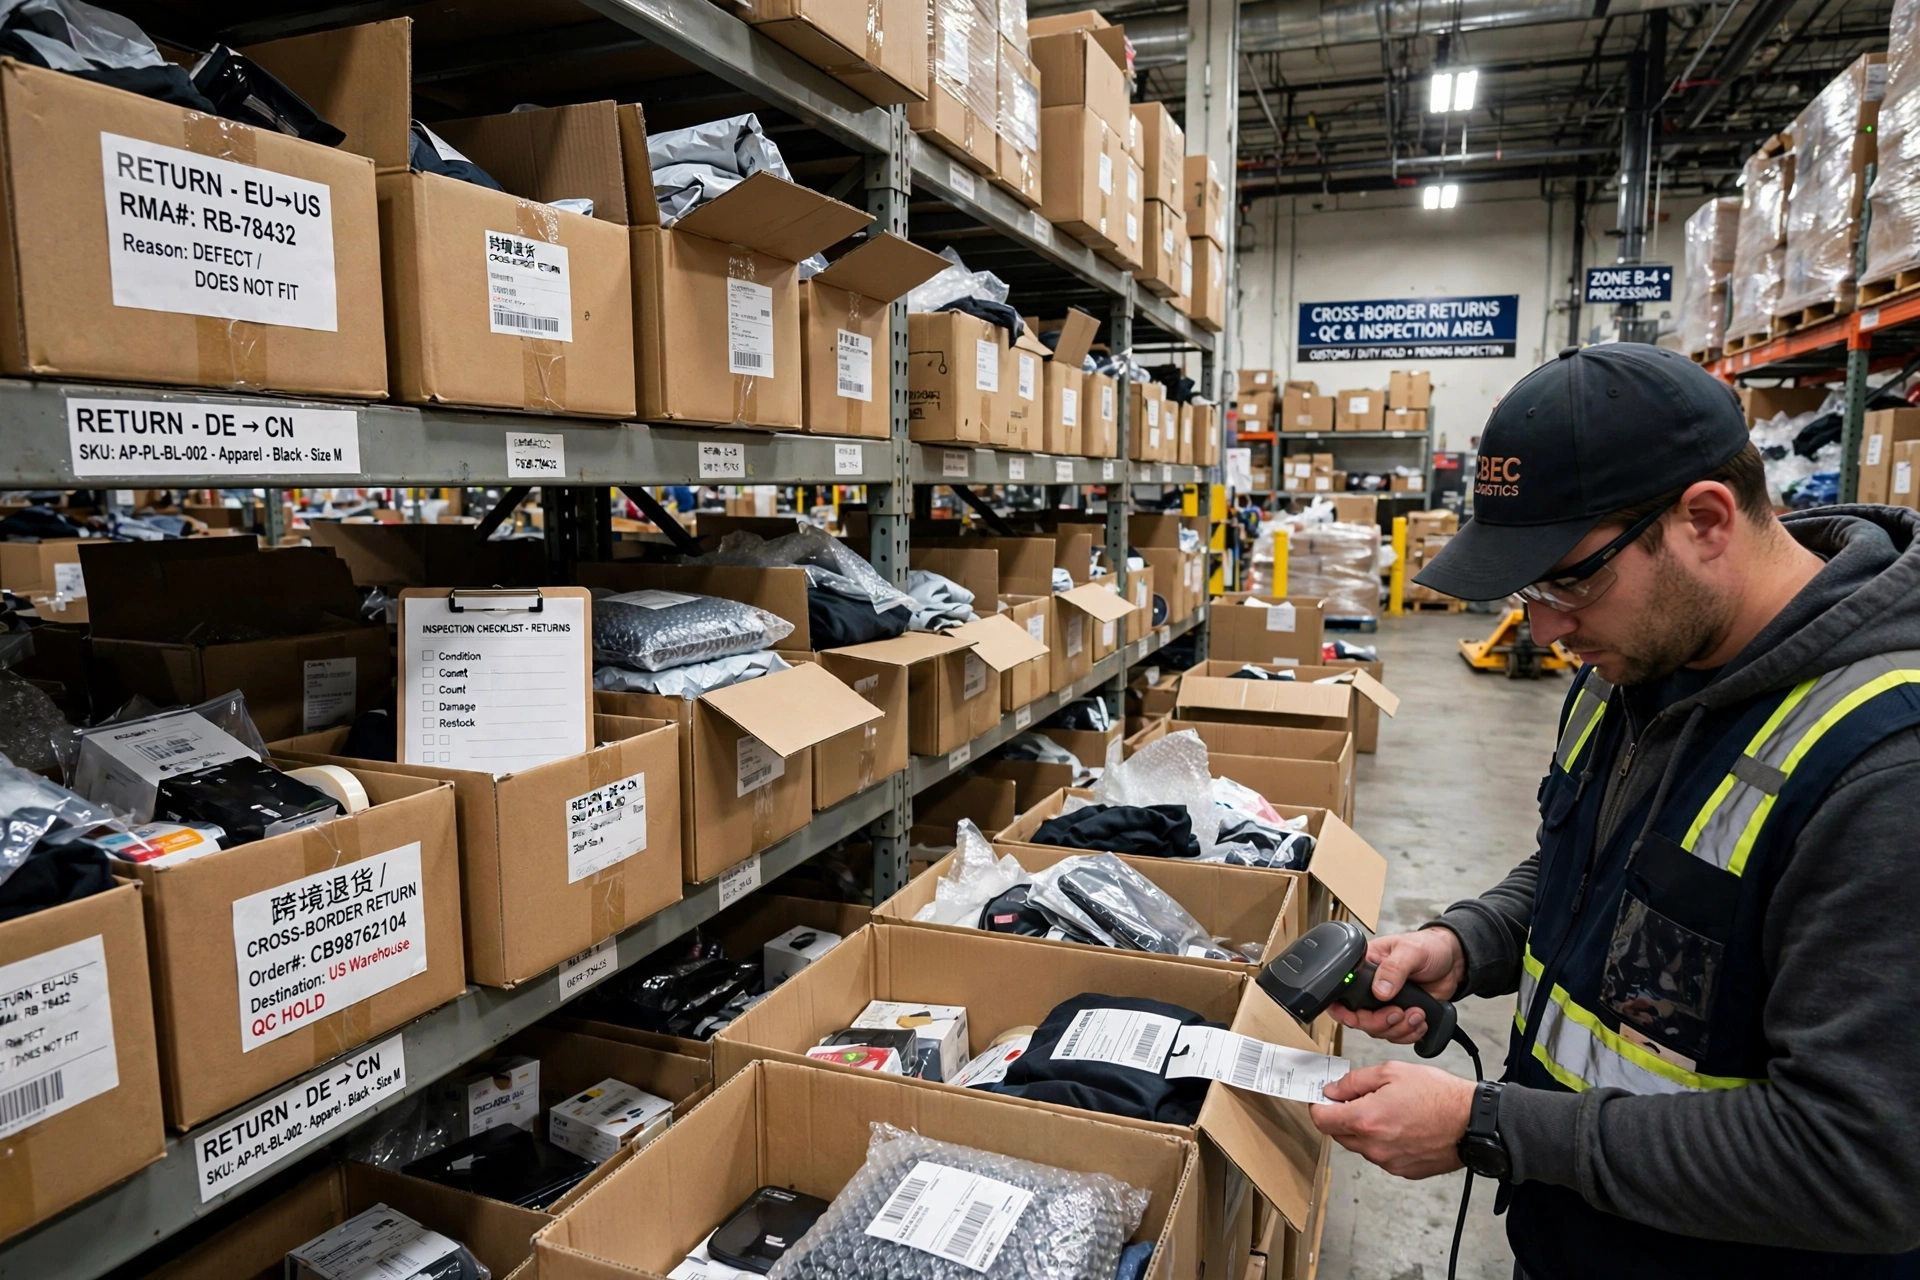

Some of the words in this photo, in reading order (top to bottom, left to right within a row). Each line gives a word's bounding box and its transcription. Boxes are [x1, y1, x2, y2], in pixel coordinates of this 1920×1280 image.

[117, 151, 223, 198] RETURN
[119, 191, 196, 228] RMA#:
[203, 207, 297, 246] RB-78432
[123, 232, 188, 260] Reason:
[193, 242, 253, 268] DEFECT
[195, 270, 239, 293] DOES
[243, 277, 274, 297] NOT
[278, 282, 299, 301] FIT
[1590, 270, 1632, 287] ZONE
[1634, 269, 1659, 285] B-4
[1588, 285, 1662, 300] PROCESSING
[1311, 302, 1426, 323] CROSS-BORDER
[1429, 300, 1500, 319] RETURNS
[1318, 324, 1341, 343] QC
[1344, 325, 1356, 341] &
[1359, 321, 1449, 340] INSPECTION
[1451, 320, 1495, 338] AREA
[1357, 347, 1380, 360] DUTY
[1381, 346, 1406, 359] HOLD
[76, 408, 184, 435] RETURN
[205, 413, 237, 437] DE
[265, 416, 294, 438] CN
[79, 443, 115, 461] SKU:
[118, 444, 208, 462] AP-PL-BL-002
[218, 446, 262, 465] Apparel
[273, 446, 302, 463] Black
[310, 447, 332, 463] Size
[333, 447, 343, 462] M
[422, 624, 475, 634] INSPECTION
[476, 623, 524, 633] CHECKLIST
[530, 623, 571, 633] RETURNS
[438, 651, 482, 662] Condition
[438, 684, 466, 695] Count
[438, 702, 477, 713] Damage
[438, 717, 476, 729] Restock
[270, 866, 374, 926] 跨境退货
[246, 901, 364, 959] CROSS-BORDER
[366, 881, 417, 914] RETURN
[248, 954, 307, 988] Order#:
[310, 910, 407, 964] CB98762104
[250, 972, 326, 1014] Destination:
[328, 962, 347, 981] US
[348, 937, 411, 973] Warehouse
[0, 990, 33, 1011] TURN
[251, 1013, 277, 1037] QC
[281, 992, 326, 1025] HOLD
[202, 1100, 290, 1164] RETURN
[305, 1078, 332, 1109] DE
[355, 1052, 381, 1080] CN
[206, 1160, 235, 1186] SKU:
[309, 1100, 342, 1129] Apparel
[348, 1085, 371, 1107] Black
[393, 1067, 401, 1081] M
